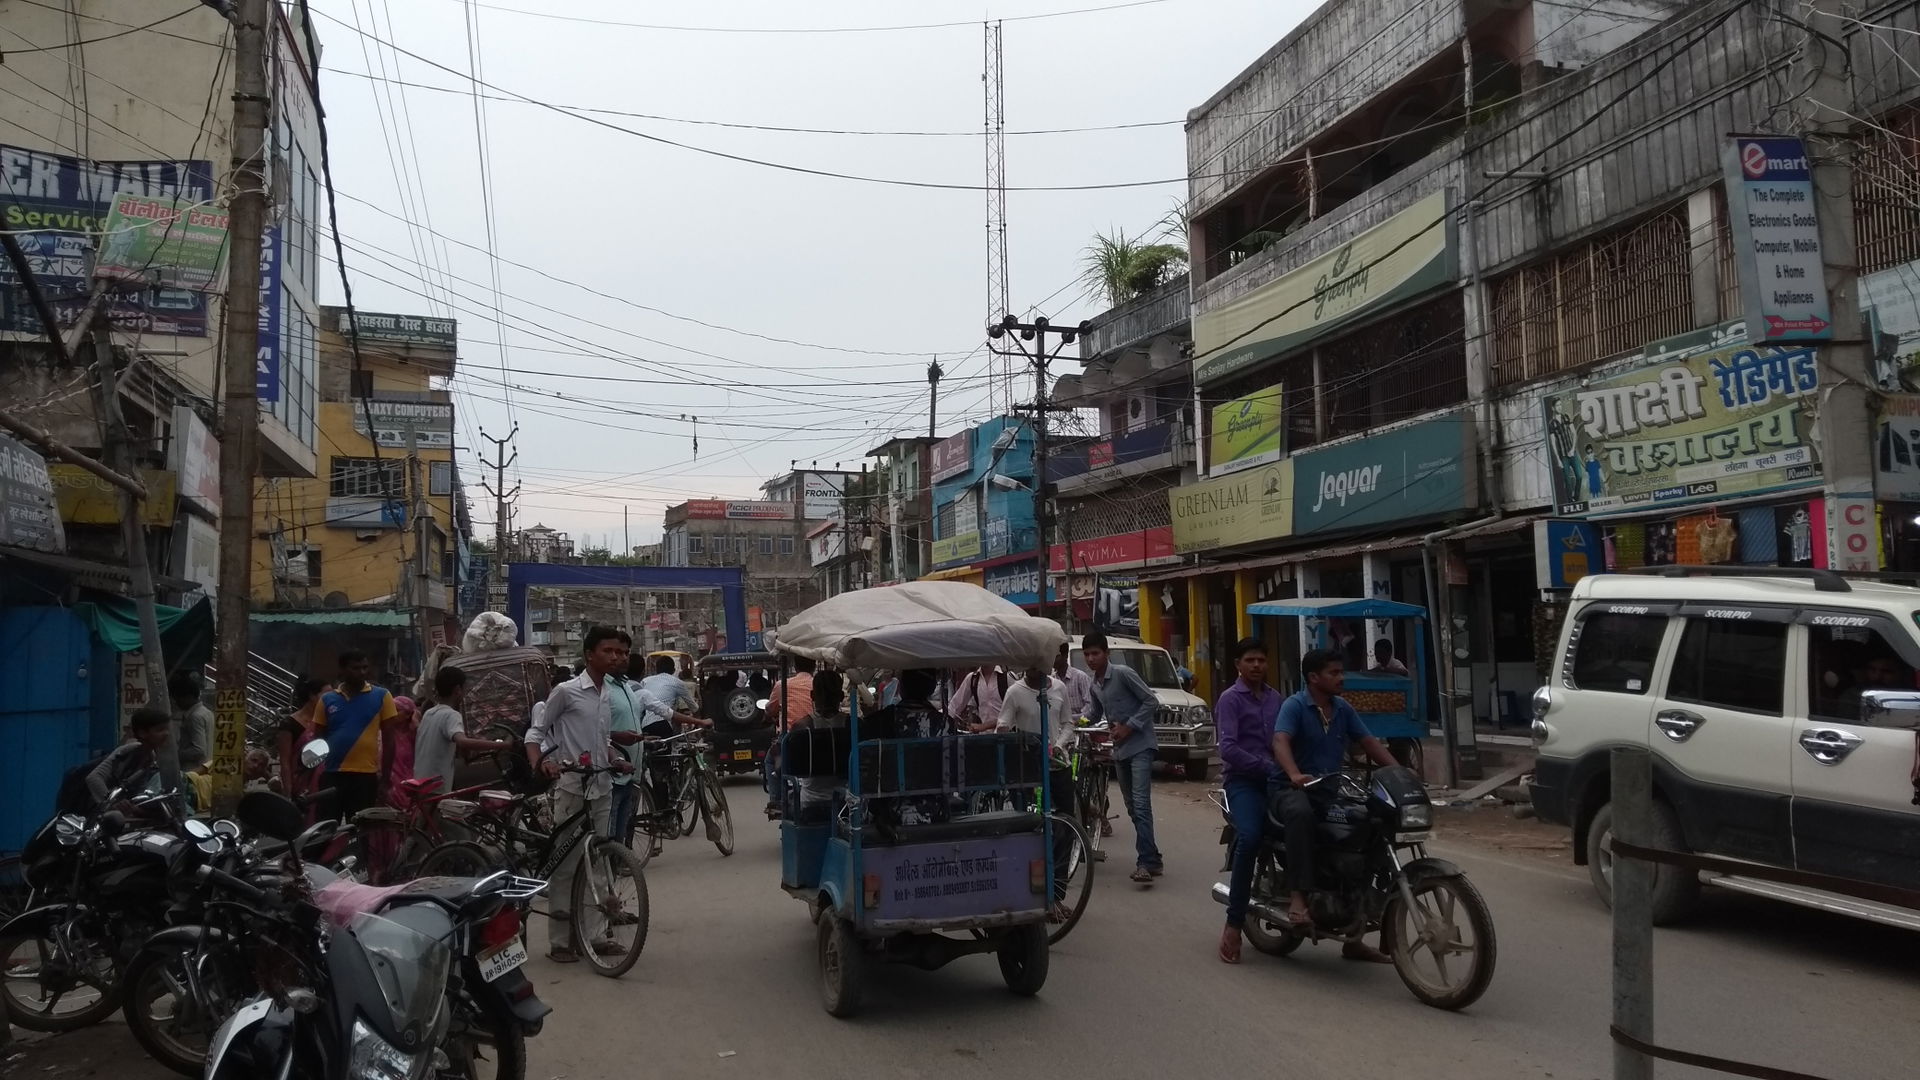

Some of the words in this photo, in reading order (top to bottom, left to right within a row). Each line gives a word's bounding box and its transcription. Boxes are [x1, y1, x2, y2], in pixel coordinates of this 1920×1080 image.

[1753, 188, 1768, 202] The
[1769, 188, 1805, 205] Complete
[1749, 213, 1791, 228] Electronics
[1793, 213, 1816, 228] Goods
[1754, 240, 1793, 255] Computer,
[1793, 239, 1818, 253] Mobile
[1776, 265, 1781, 278] &
[1783, 265, 1805, 279] Home
[1774, 290, 1814, 308] Appliances
[394, 404, 450, 418] COMPUTERS
[805, 489, 845, 498] FRONTLIN
[1312, 464, 1382, 512] Jaquar
[1653, 487, 1684, 498] Sparky
[1690, 484, 1715, 493] Lee
[1176, 483, 1249, 518] GREENLAM
[1087, 546, 1127, 561] VIMAL
[1608, 605, 1649, 615] SCORPIO
[1705, 609, 1751, 620] SCORPIO
[1812, 615, 1870, 626] SCORPIO
[491, 949, 510, 965] LIC
